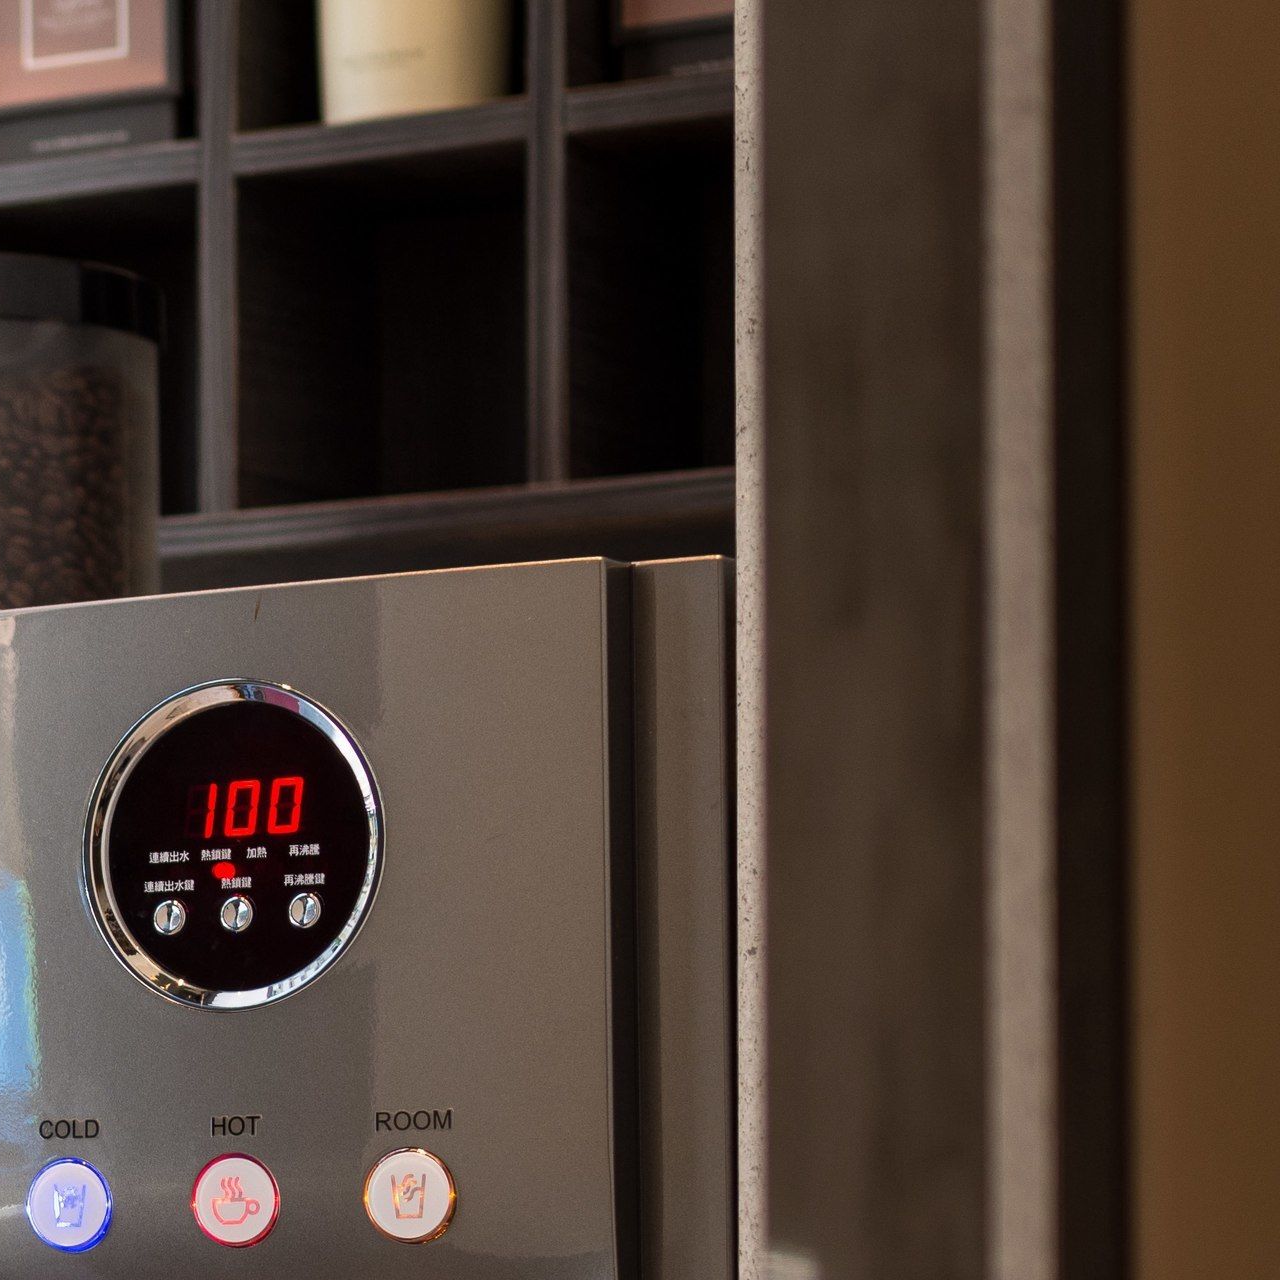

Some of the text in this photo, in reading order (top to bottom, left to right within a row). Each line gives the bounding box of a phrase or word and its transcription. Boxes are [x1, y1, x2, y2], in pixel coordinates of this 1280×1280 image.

[204, 777, 304, 838] 100
[246, 847, 267, 859] 加熱
[289, 844, 320, 856] 再沸騰
[149, 851, 189, 864] 連續出水
[144, 879, 195, 893] 連續出水鍵
[284, 873, 325, 886] 再沸騰鍵
[211, 1115, 261, 1136] HOT
[374, 1109, 453, 1132] ROOM
[39, 1119, 100, 1139] COLD
